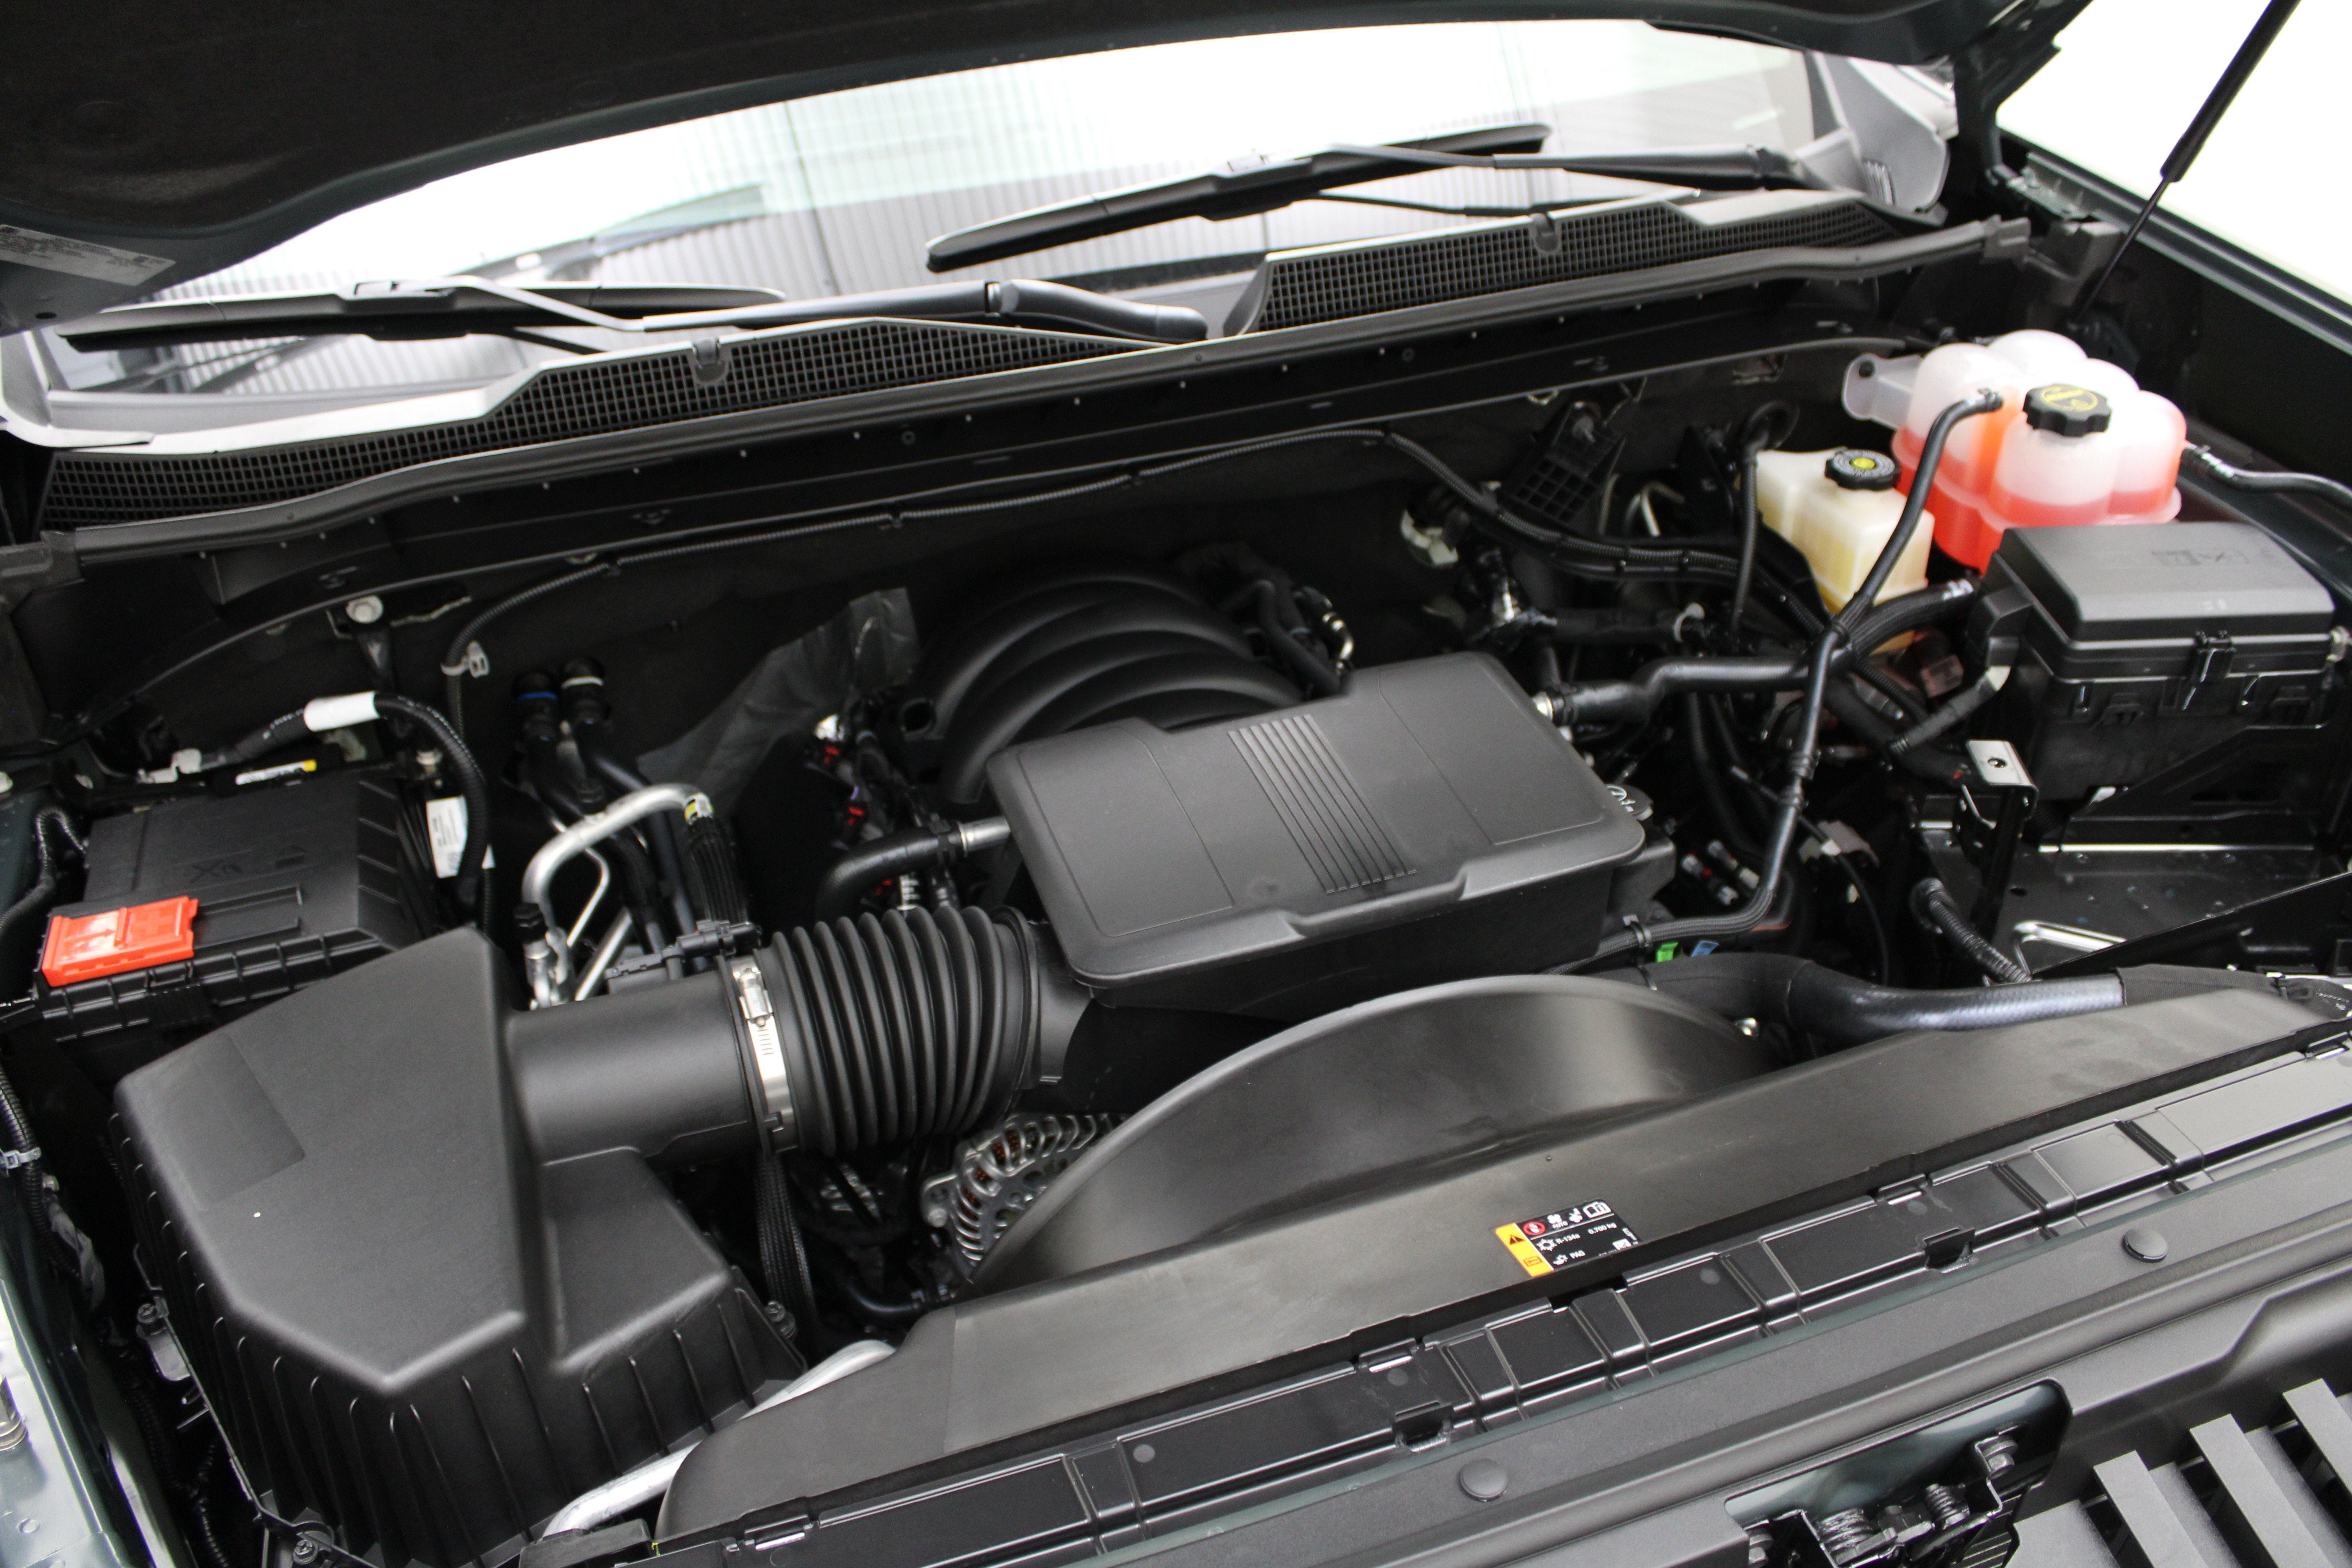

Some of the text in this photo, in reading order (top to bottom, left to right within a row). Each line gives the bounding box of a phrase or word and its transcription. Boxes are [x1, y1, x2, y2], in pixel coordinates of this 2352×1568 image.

[1552, 1221, 1568, 1229] AUTO
[1588, 1225, 1607, 1234] 0.700
[1555, 1233, 1581, 1244] R-134a
[1569, 1250, 1586, 1259] PAG
